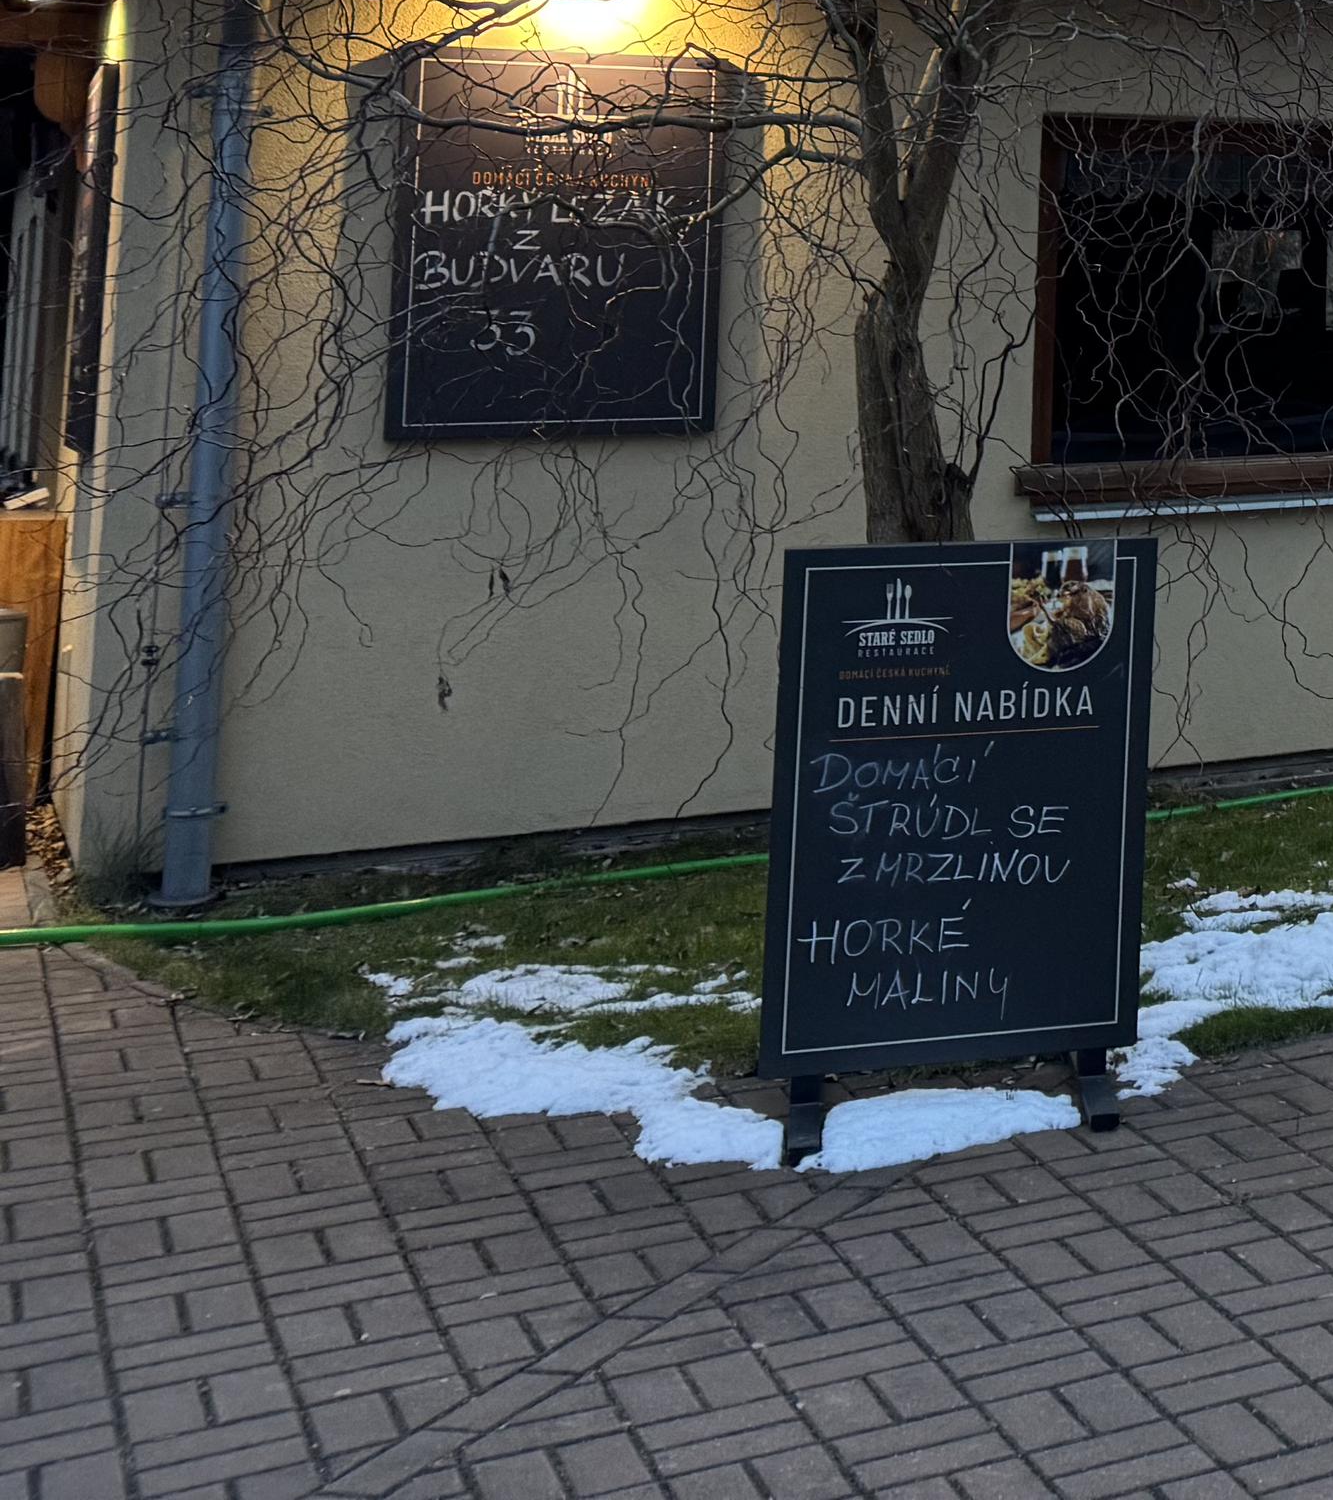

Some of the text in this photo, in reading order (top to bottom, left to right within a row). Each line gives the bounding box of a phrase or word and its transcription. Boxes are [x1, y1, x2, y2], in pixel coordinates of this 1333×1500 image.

[512, 229, 542, 250] Z
[414, 250, 626, 290] BUDVARU
[857, 646, 935, 658] RESTAURACE
[858, 628, 935, 647] STARÉ SEDLO
[836, 678, 1094, 729] DENNÍ NABÍDKA
[809, 740, 995, 794] DOMÁCÍ
[828, 792, 1070, 841] ŠTRÚDL SE
[796, 897, 973, 965] HORKÉ
[846, 967, 1009, 1021] MALINY
